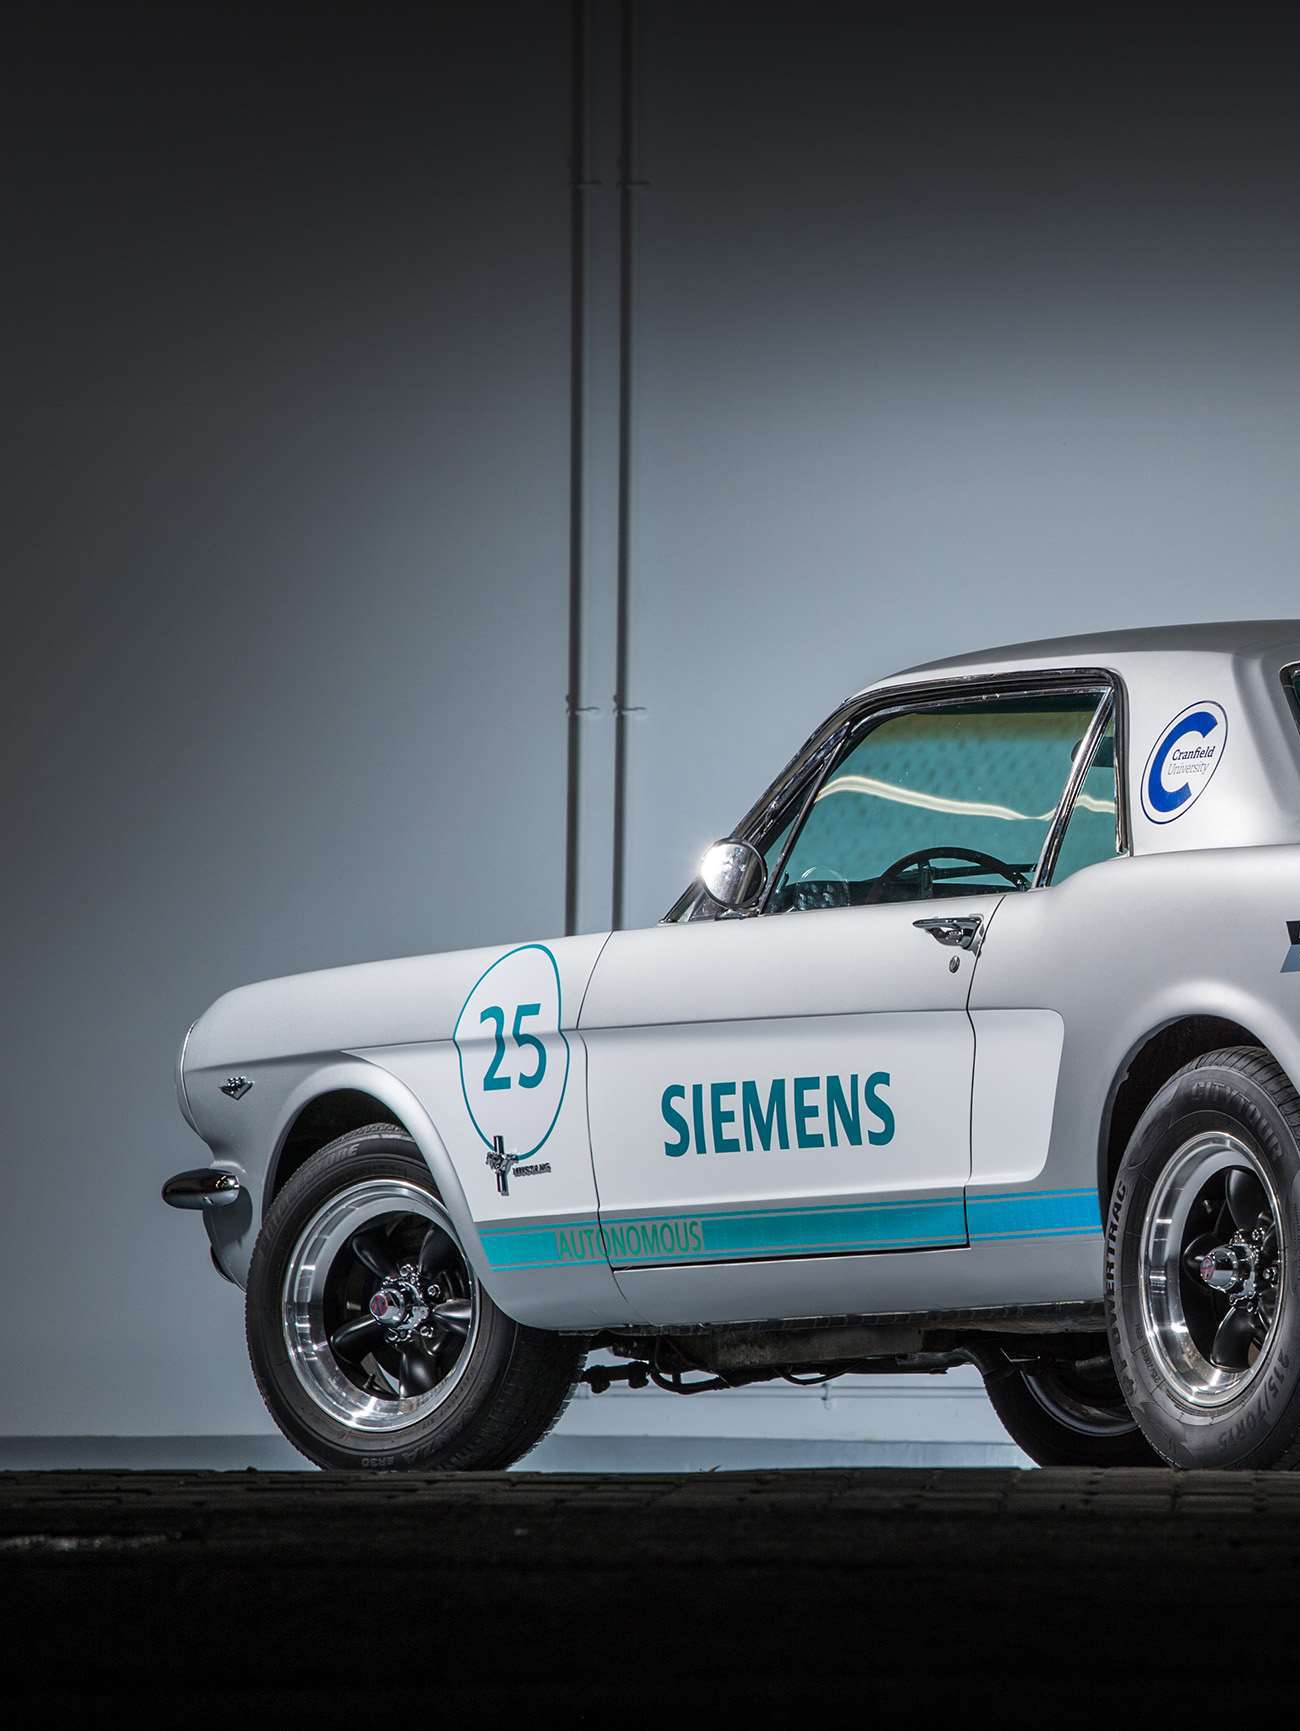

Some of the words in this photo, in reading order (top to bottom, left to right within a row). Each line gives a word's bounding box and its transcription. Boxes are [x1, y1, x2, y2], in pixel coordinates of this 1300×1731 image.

[1172, 746, 1216, 761] Cranfield
[1168, 762, 1209, 775] University
[479, 1003, 547, 1092] 25
[661, 1071, 895, 1158] SIEMENS
[512, 1163, 552, 1177] MUSTANG
[559, 1220, 701, 1260] AUTONOMOUS
